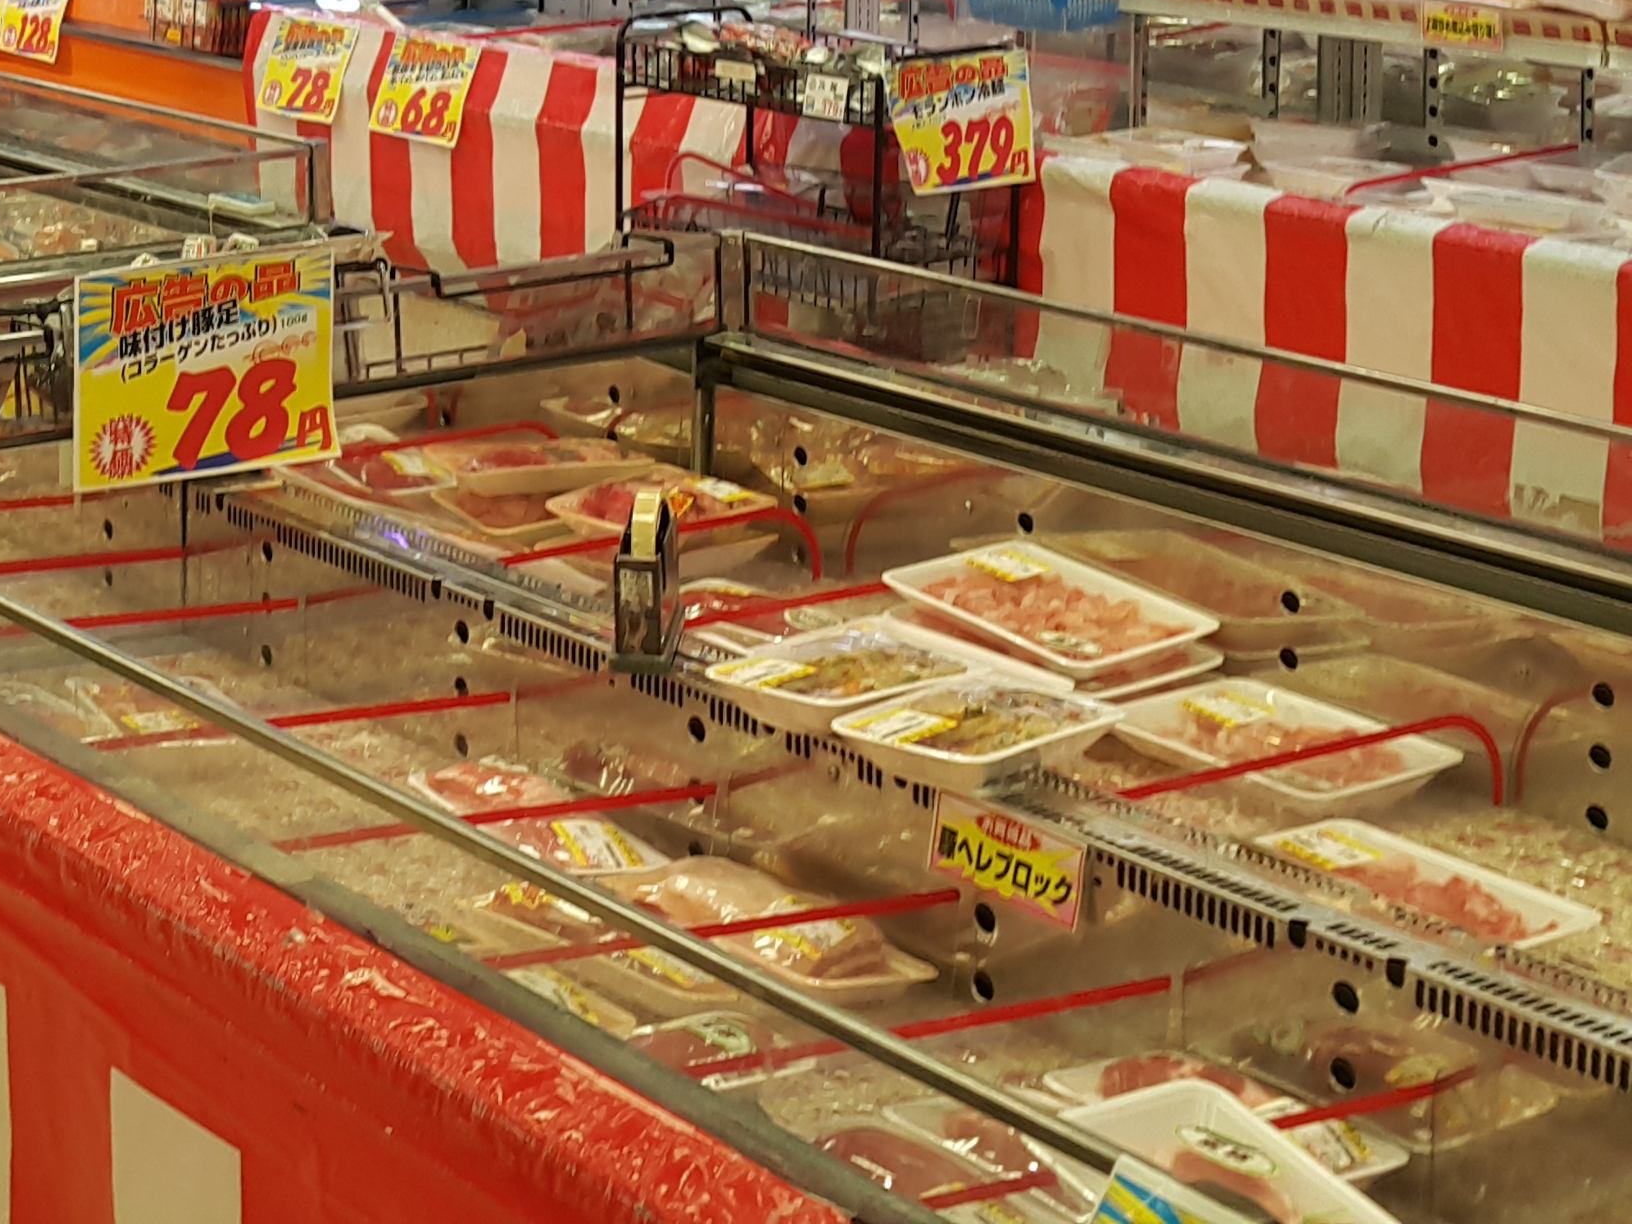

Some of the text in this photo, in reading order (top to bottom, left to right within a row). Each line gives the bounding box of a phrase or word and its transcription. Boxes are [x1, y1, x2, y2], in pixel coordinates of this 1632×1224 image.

[285, 67, 335, 117] 78円
[400, 87, 458, 142] 68円
[936, 115, 1030, 186] 379円
[109, 260, 301, 334] 広告の品
[119, 299, 241, 360] 味付け豚足
[166, 358, 333, 471] 78円
